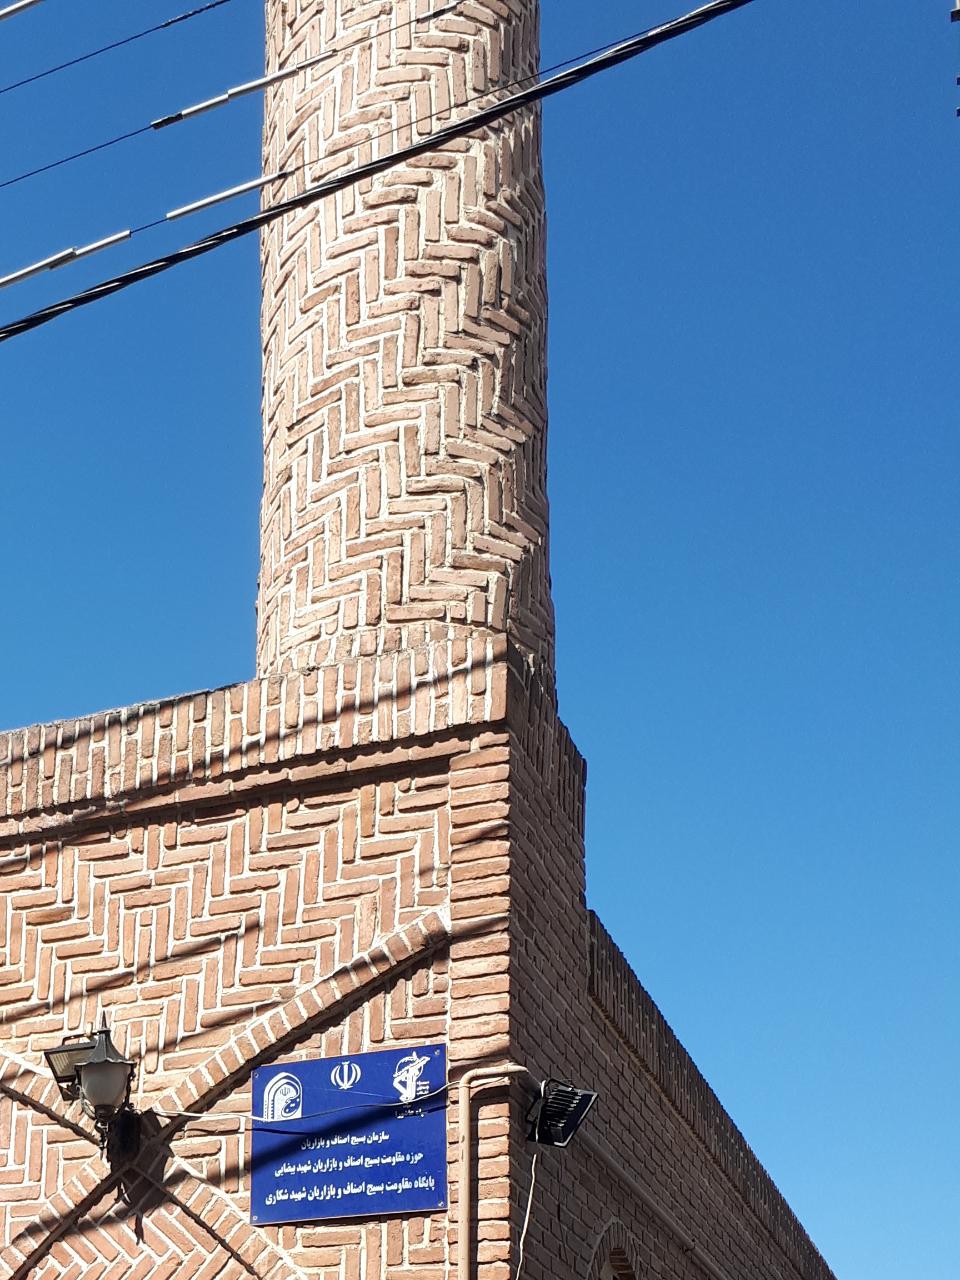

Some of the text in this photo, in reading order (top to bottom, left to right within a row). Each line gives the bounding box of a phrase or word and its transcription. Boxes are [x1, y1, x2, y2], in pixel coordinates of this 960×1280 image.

[301, 1137, 325, 1150] بازاریان
[330, 1134, 350, 1145] اصناف
[350, 1135, 366, 1145] بسیج
[366, 1131, 390, 1144] سازمان
[343, 1155, 364, 1167] اصناف
[364, 1156, 380, 1167] بسیج
[381, 1152, 405, 1166] مقاومت
[406, 1152, 424, 1164] حوزه
[296, 1160, 312, 1173] شهید
[312, 1158, 338, 1173] بازاریان
[265, 1175, 435, 1205] پایگاه مقاومت بسیج اصناف و بازاریان شهید شکاری
